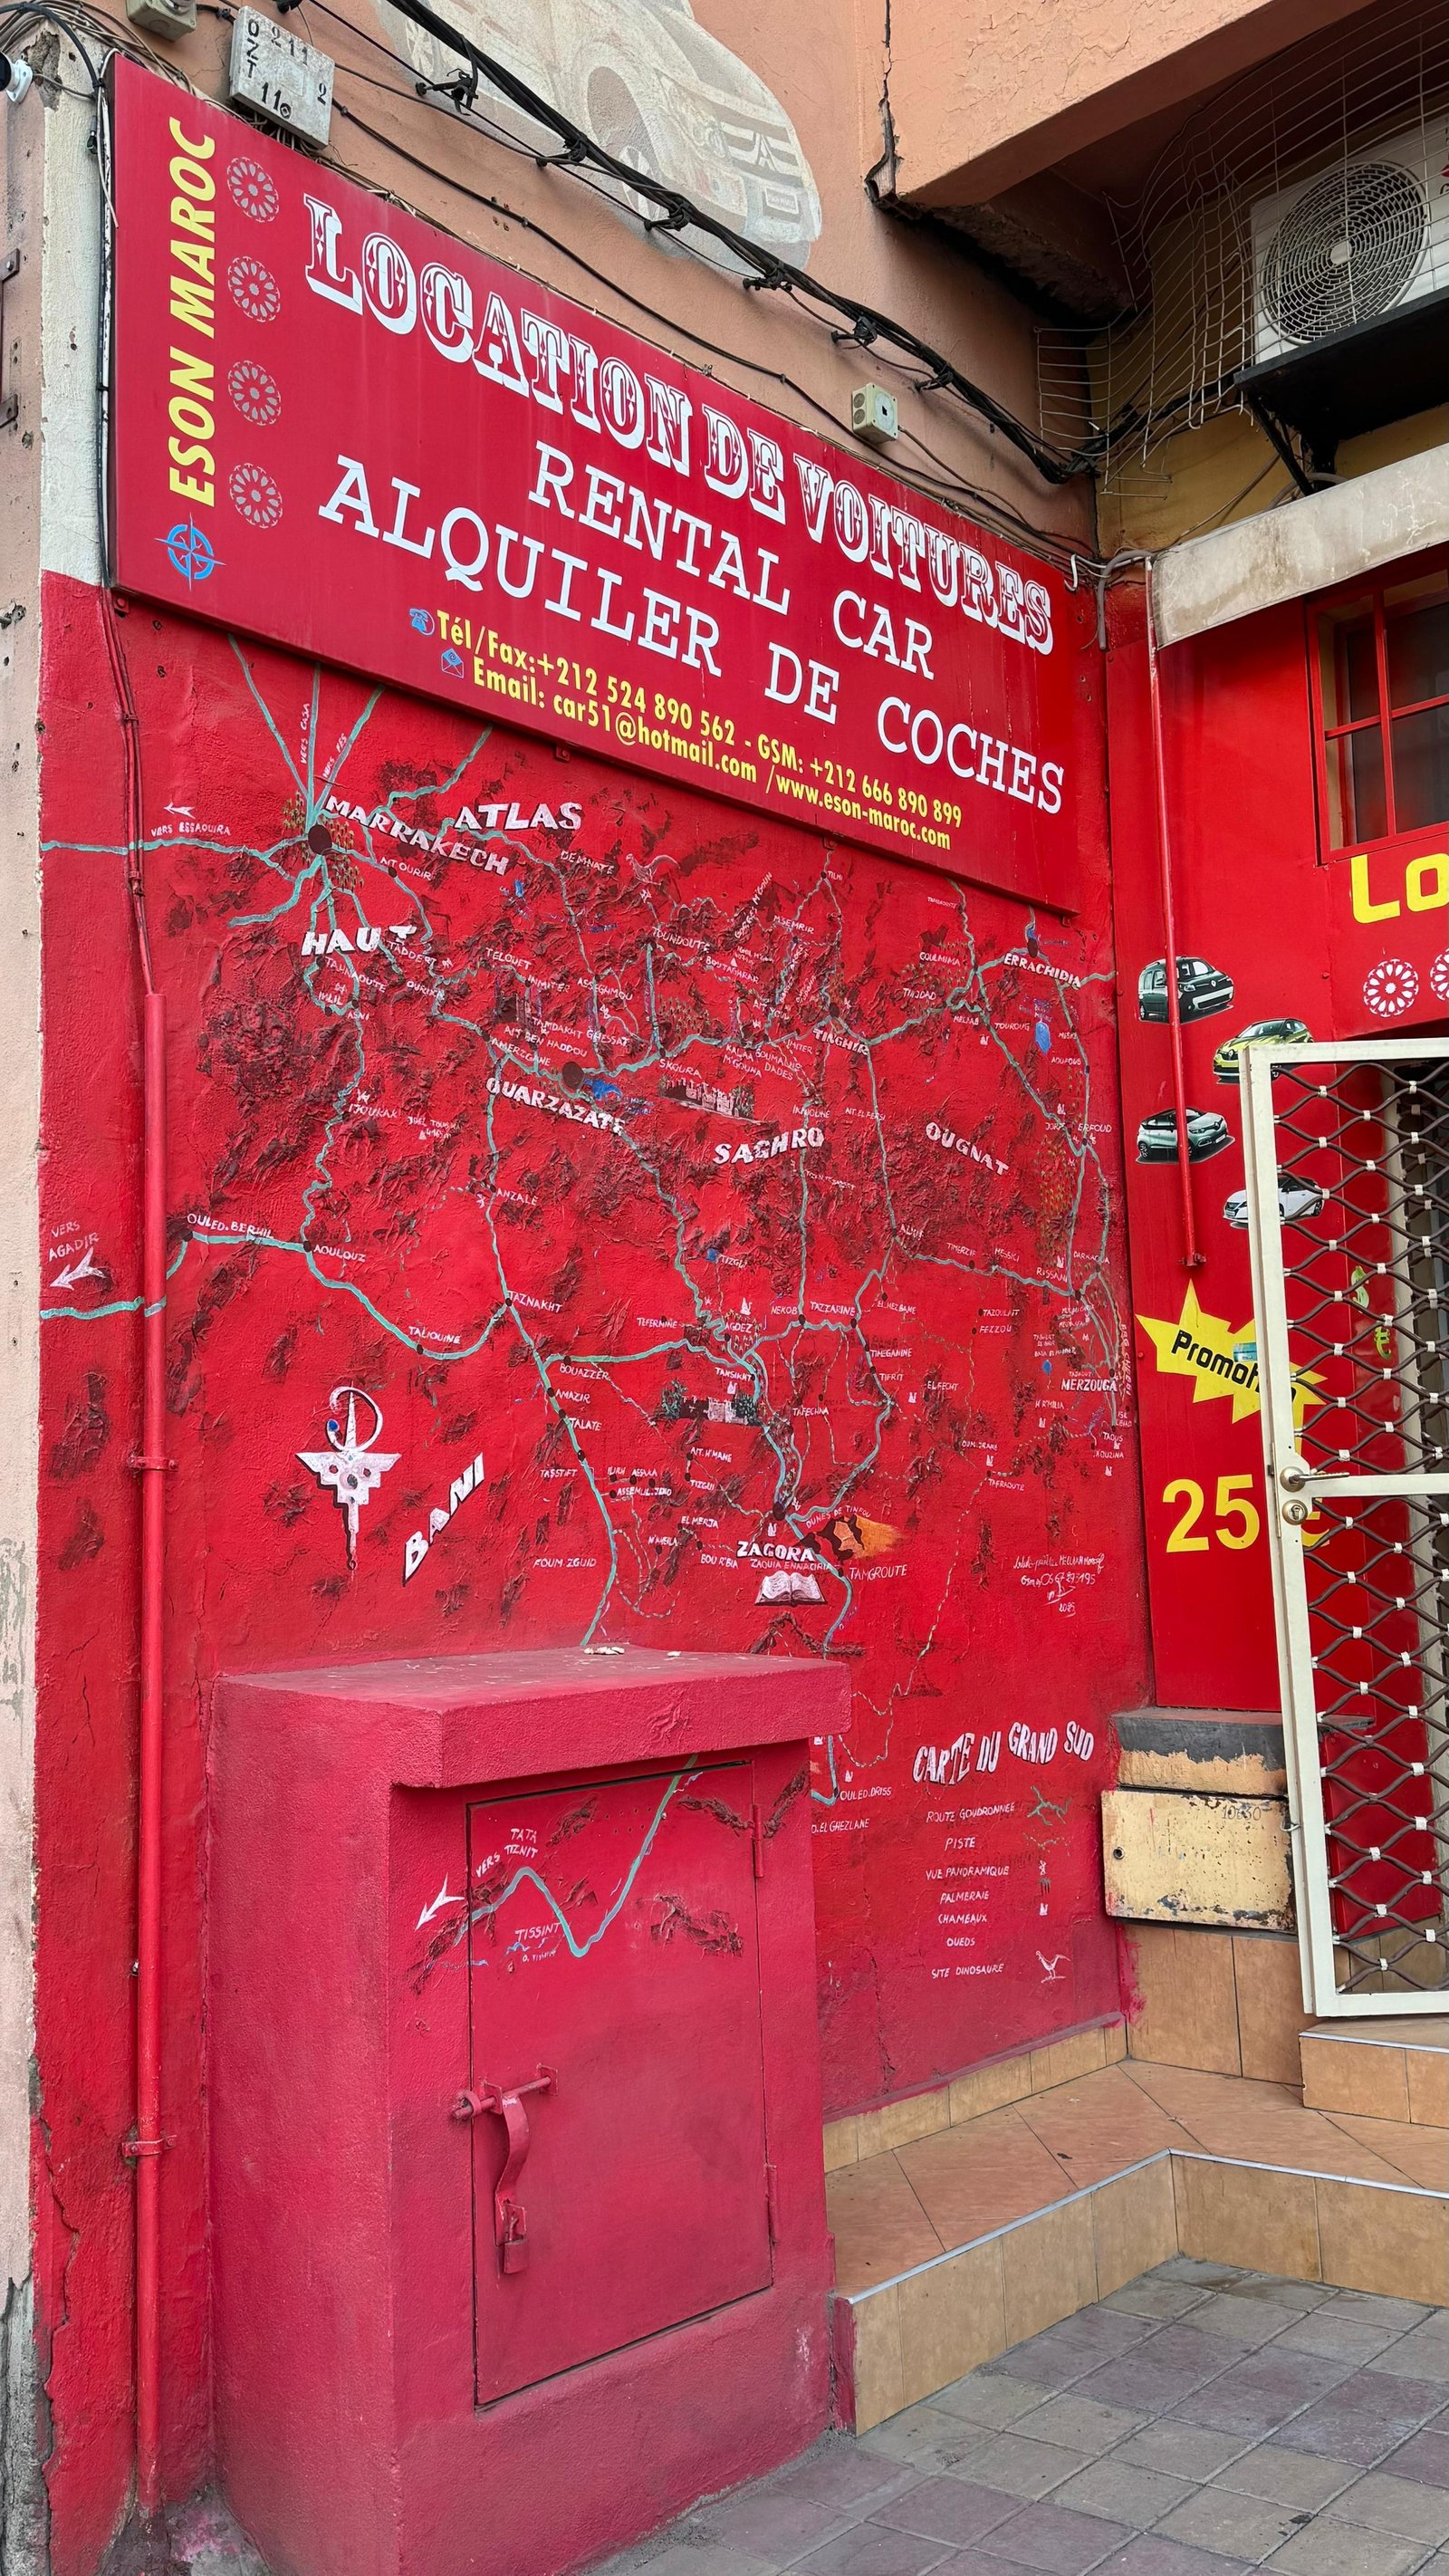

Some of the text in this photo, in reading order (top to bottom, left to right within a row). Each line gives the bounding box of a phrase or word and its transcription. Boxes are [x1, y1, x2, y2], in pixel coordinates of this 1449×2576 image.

[169, 117, 216, 507] ESON MAROC
[302, 193, 1054, 656] LOCATION DE VOITURES
[528, 441, 935, 681] RENTAL CAR
[319, 455, 1064, 814] ALQUILER DE COCHES
[473, 660, 544, 710] Email:
[553, 697, 757, 785] car51@hotmail.com
[607, 675, 647, 713] 524
[654, 694, 693, 731] 890
[700, 711, 735, 746] 562
[758, 734, 803, 774] GSM:
[810, 756, 856, 793] +212
[861, 773, 892, 804] 666
[897, 786, 927, 819] 890
[931, 799, 962, 828] 899
[454, 802, 582, 831] ATLAS
[179, 822, 231, 836] ESSAOUIRA
[325, 795, 510, 875] MARRAKECH
[398, 862, 433, 882] OURIR
[561, 850, 615, 876] DEMNATE
[302, 924, 417, 956] HAUT
[652, 926, 711, 954] TOUNDOUTE
[389, 940, 437, 966] TADDERT
[485, 947, 533, 970] TELOUET
[1003, 952, 1081, 990] ERRACHIDIA
[524, 1031, 544, 1045] BEN
[547, 1041, 588, 1058] HADDOU
[813, 1028, 869, 1056] TINGHIR
[658, 1057, 703, 1080] SKOURA
[764, 1062, 793, 1081] DADES
[485, 1076, 626, 1137] OUARZAZATE
[1078, 1123, 1112, 1133] ERFOUD
[713, 1128, 825, 1165] SAGHRO
[926, 1121, 1010, 1176] OUGNAT
[51, 1220, 81, 1238] VERS
[48, 1232, 100, 1262] AGADIR
[312, 1245, 366, 1264] AOULOUZ
[507, 1290, 562, 1313] TAZNAKHT
[810, 1301, 856, 1317] TAZZARINE
[408, 1326, 461, 1345] TALIOUINE
[1060, 1378, 1118, 1392] MERZOUGA
[404, 1452, 485, 1581] BANI
[805, 1510, 831, 1529] DUNES
[833, 1506, 842, 1517] DE
[736, 1540, 816, 1563] ZAGORA
[849, 1564, 907, 1581] TAMGROUTE
[913, 1720, 1094, 1785] CARTE DU GRAND SUD
[926, 1811, 955, 1822] ROUTE
[511, 1828, 537, 1843] TATA
[945, 1838, 976, 1850] PISTE
[475, 1851, 501, 1878] VERS
[926, 1866, 1010, 1880] VUE PANORAMIQUE
[940, 1890, 990, 1904] PALMERAIE
[938, 1913, 987, 1925] CHAMEAUX
[515, 1922, 561, 1942] TISSINT
[946, 1937, 975, 1947] OUEDS
[931, 1964, 1004, 1979] SITE DINOSAURE
